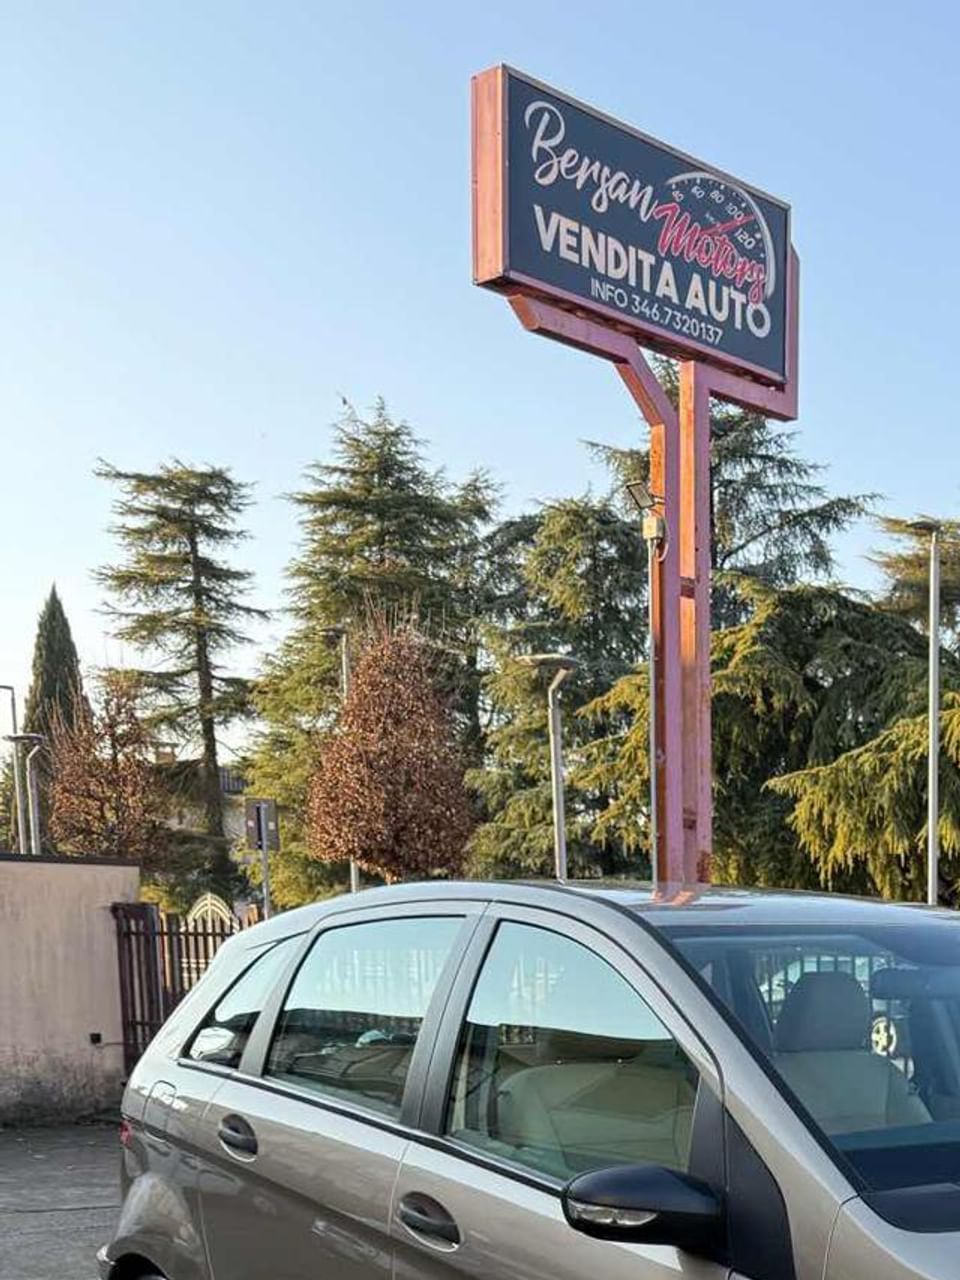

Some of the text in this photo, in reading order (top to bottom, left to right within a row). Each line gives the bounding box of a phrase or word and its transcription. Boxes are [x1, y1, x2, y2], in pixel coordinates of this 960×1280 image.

[524, 101, 765, 305] Bersan Motors
[725, 202, 745, 221] 100
[533, 204, 771, 338] VENDITA AUTO
[734, 228, 756, 249] 120
[591, 278, 722, 345] INFO 346.7320137
